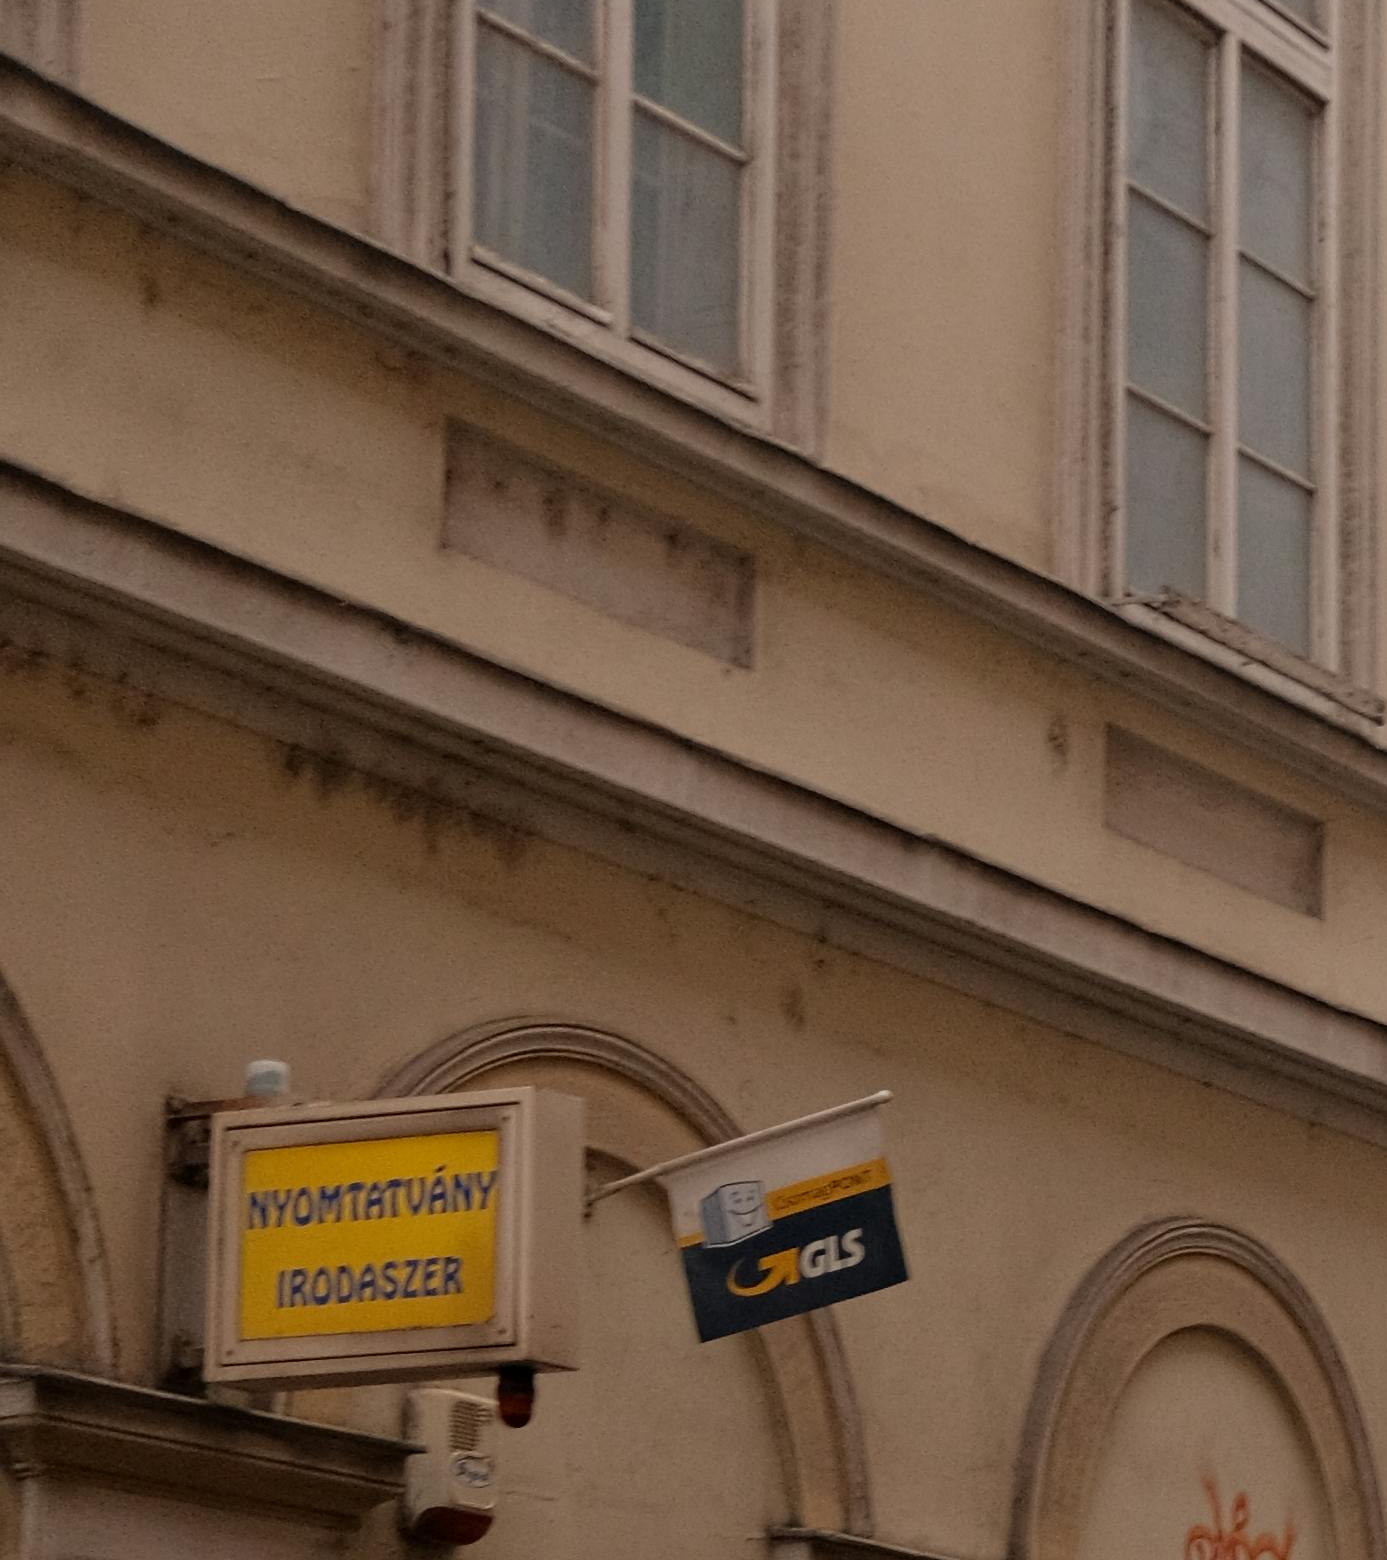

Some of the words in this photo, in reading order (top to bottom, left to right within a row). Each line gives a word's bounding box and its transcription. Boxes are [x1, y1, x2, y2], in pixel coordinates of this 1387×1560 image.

[249, 1163, 498, 1230] NYOMTATVÁNY
[799, 1227, 867, 1280] GLS
[276, 1255, 464, 1309] IRODASZER
